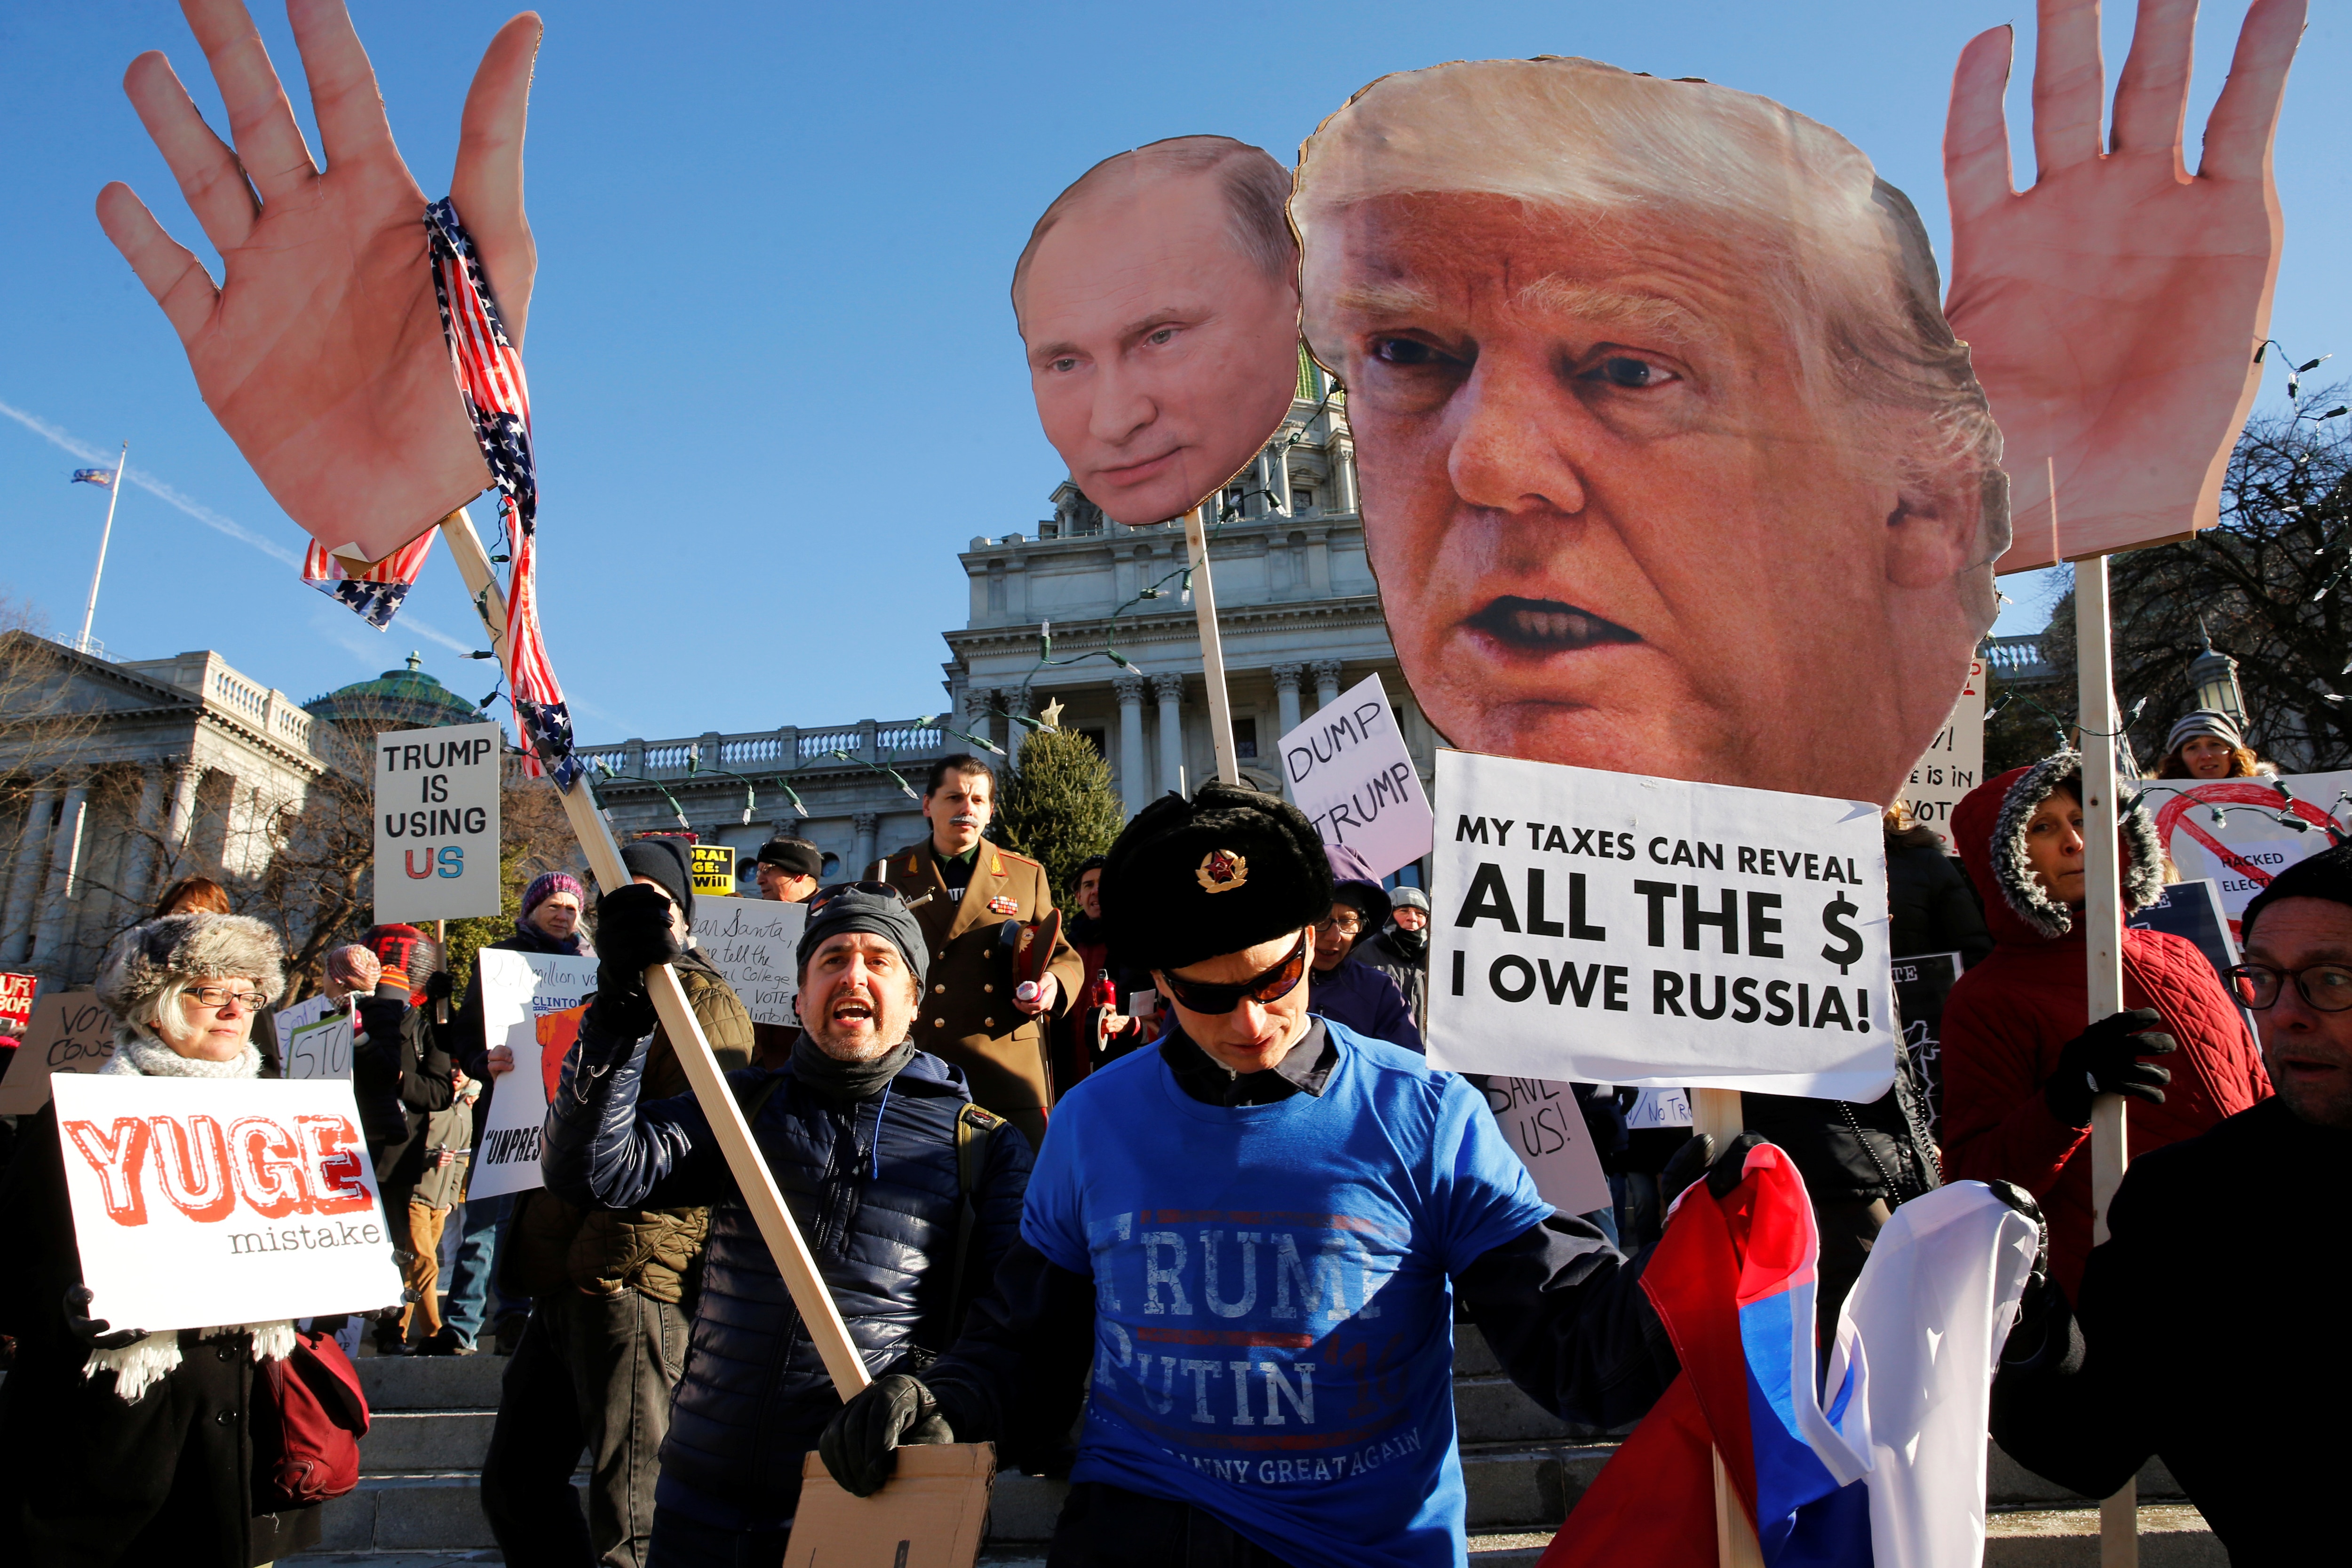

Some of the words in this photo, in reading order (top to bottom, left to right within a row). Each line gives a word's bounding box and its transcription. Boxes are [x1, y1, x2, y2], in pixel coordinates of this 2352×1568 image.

[383, 739, 491, 772] TRUMP
[1287, 702, 1380, 783] DUMP
[422, 774, 448, 803] IS
[1311, 762, 1409, 844] TRUMP
[386, 807, 486, 837] USING
[1906, 801, 1956, 821] VOT
[405, 846, 463, 879] US
[1455, 814, 1515, 846] MY
[1527, 822, 1635, 861] TAXES
[1649, 836, 1724, 870] CAN
[1738, 846, 1863, 885] REVEAL
[2221, 853, 2283, 868] HACKED
[693, 876, 727, 887] Will
[721, 908, 792, 948] Santa,
[1454, 862, 1606, 942] ALL
[1634, 879, 1784, 959] THE
[1820, 891, 1863, 976] $
[723, 939, 750, 964] tell
[751, 945, 774, 969] the
[531, 961, 575, 988] million
[582, 971, 598, 987] vo
[742, 967, 790, 989] College
[755, 989, 789, 1004] VOTE
[1452, 950, 1465, 996] I
[1489, 954, 1628, 1011] OWE
[1653, 969, 1871, 1034] RUSSIA!
[62, 1004, 117, 1035] VOT
[294, 1022, 351, 1079] STO
[1520, 1101, 1571, 1157] US!
[62, 1114, 374, 1227] YUGE
[227, 1221, 381, 1255] mistake
[1095, 1322, 1316, 1425] PUTIN
[1258, 1455, 1346, 1485] GREAT
[1350, 1426, 1422, 1477] AGAIN
